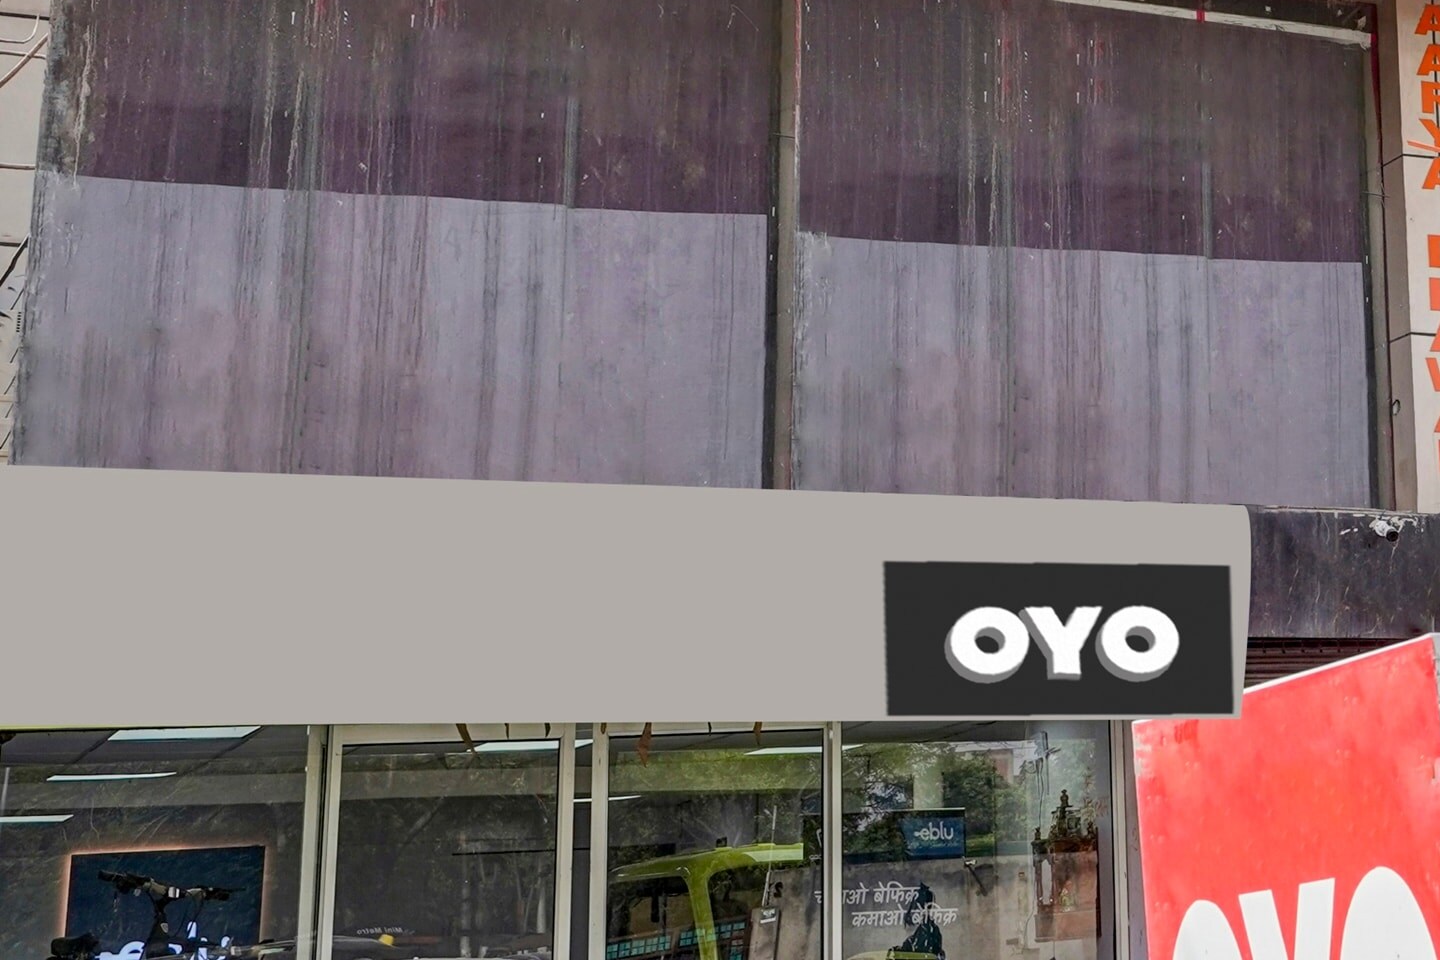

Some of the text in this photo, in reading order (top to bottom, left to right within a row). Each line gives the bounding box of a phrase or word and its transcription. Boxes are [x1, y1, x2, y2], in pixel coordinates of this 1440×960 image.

[945, 605, 1180, 683] OYO
[919, 821, 954, 841] eblu
[851, 904, 907, 927] कमाओ
